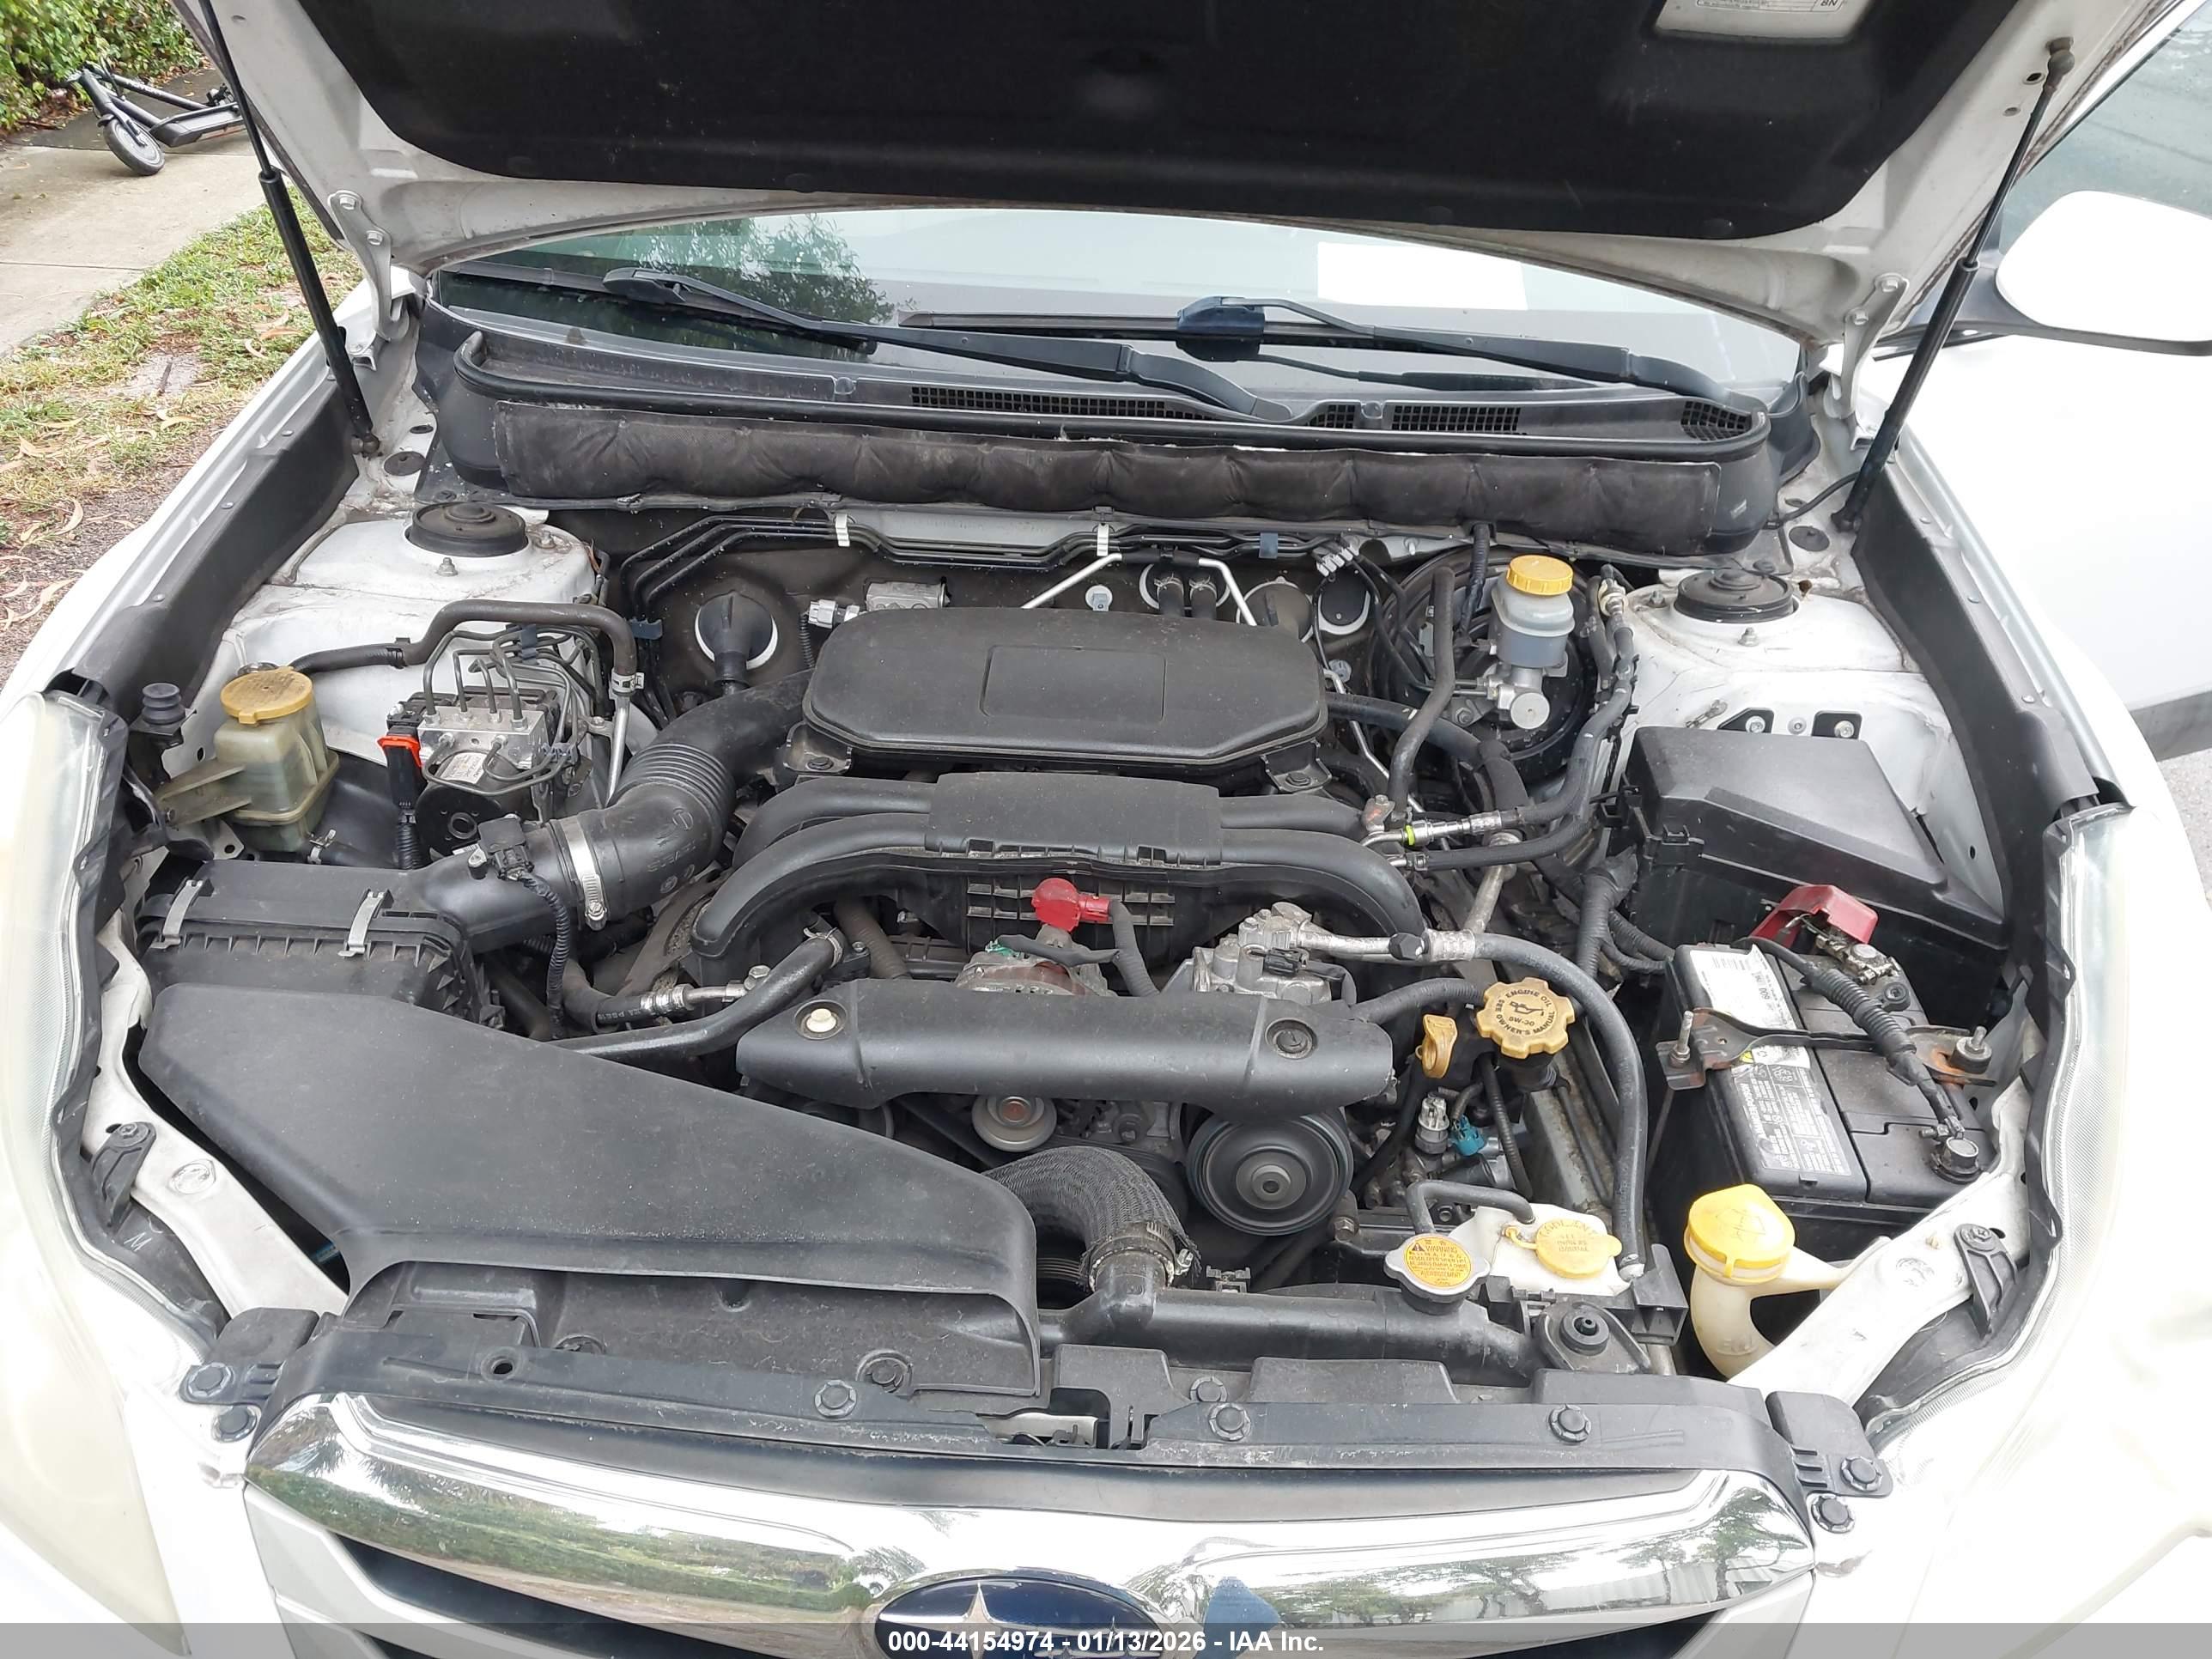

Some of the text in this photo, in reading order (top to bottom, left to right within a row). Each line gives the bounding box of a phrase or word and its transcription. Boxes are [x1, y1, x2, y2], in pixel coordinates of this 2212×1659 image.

[1505, 989, 1552, 1007] ENGINE OIL
[1495, 1000, 1505, 1012] SEE
[1533, 1011, 1555, 1034] MANUAL
[1425, 1245, 1458, 1254] WARNING
